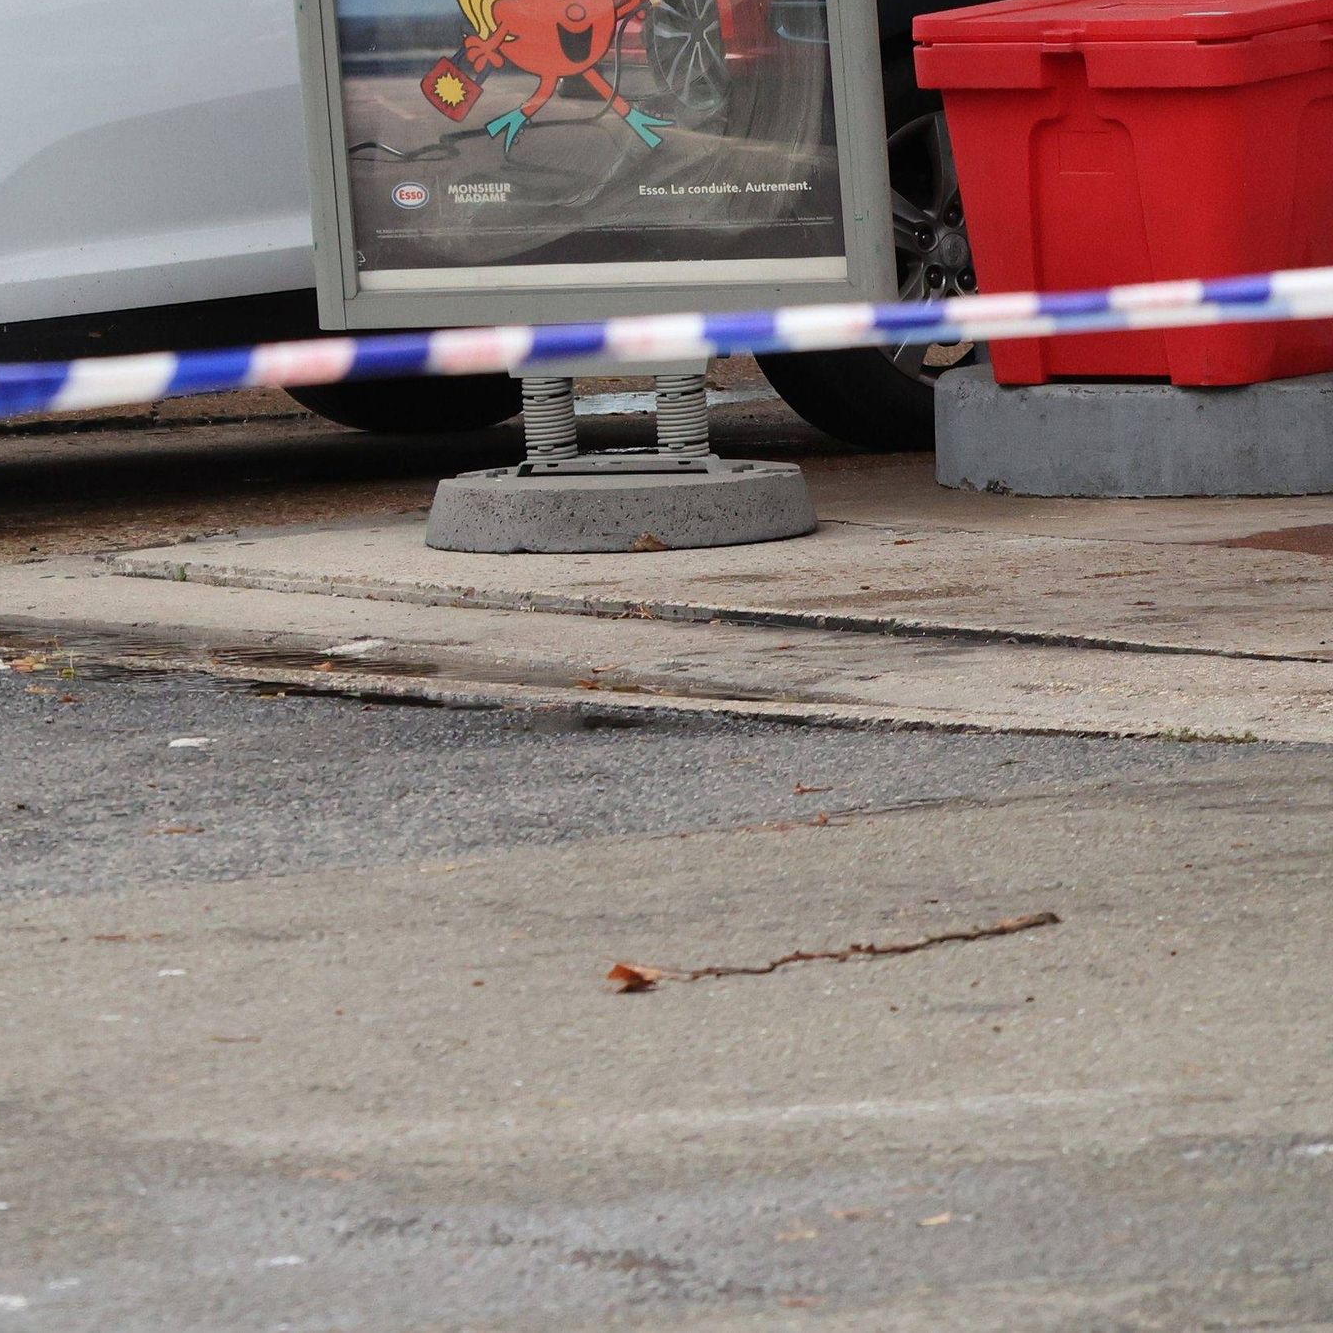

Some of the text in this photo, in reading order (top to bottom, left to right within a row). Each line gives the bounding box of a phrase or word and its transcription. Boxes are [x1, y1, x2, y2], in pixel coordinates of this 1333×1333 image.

[448, 183, 512, 195] MONSIEUR
[639, 181, 813, 196] Esso. La conduite. Autrement.
[399, 189, 424, 200] Esso
[454, 192, 507, 203] MADAME
